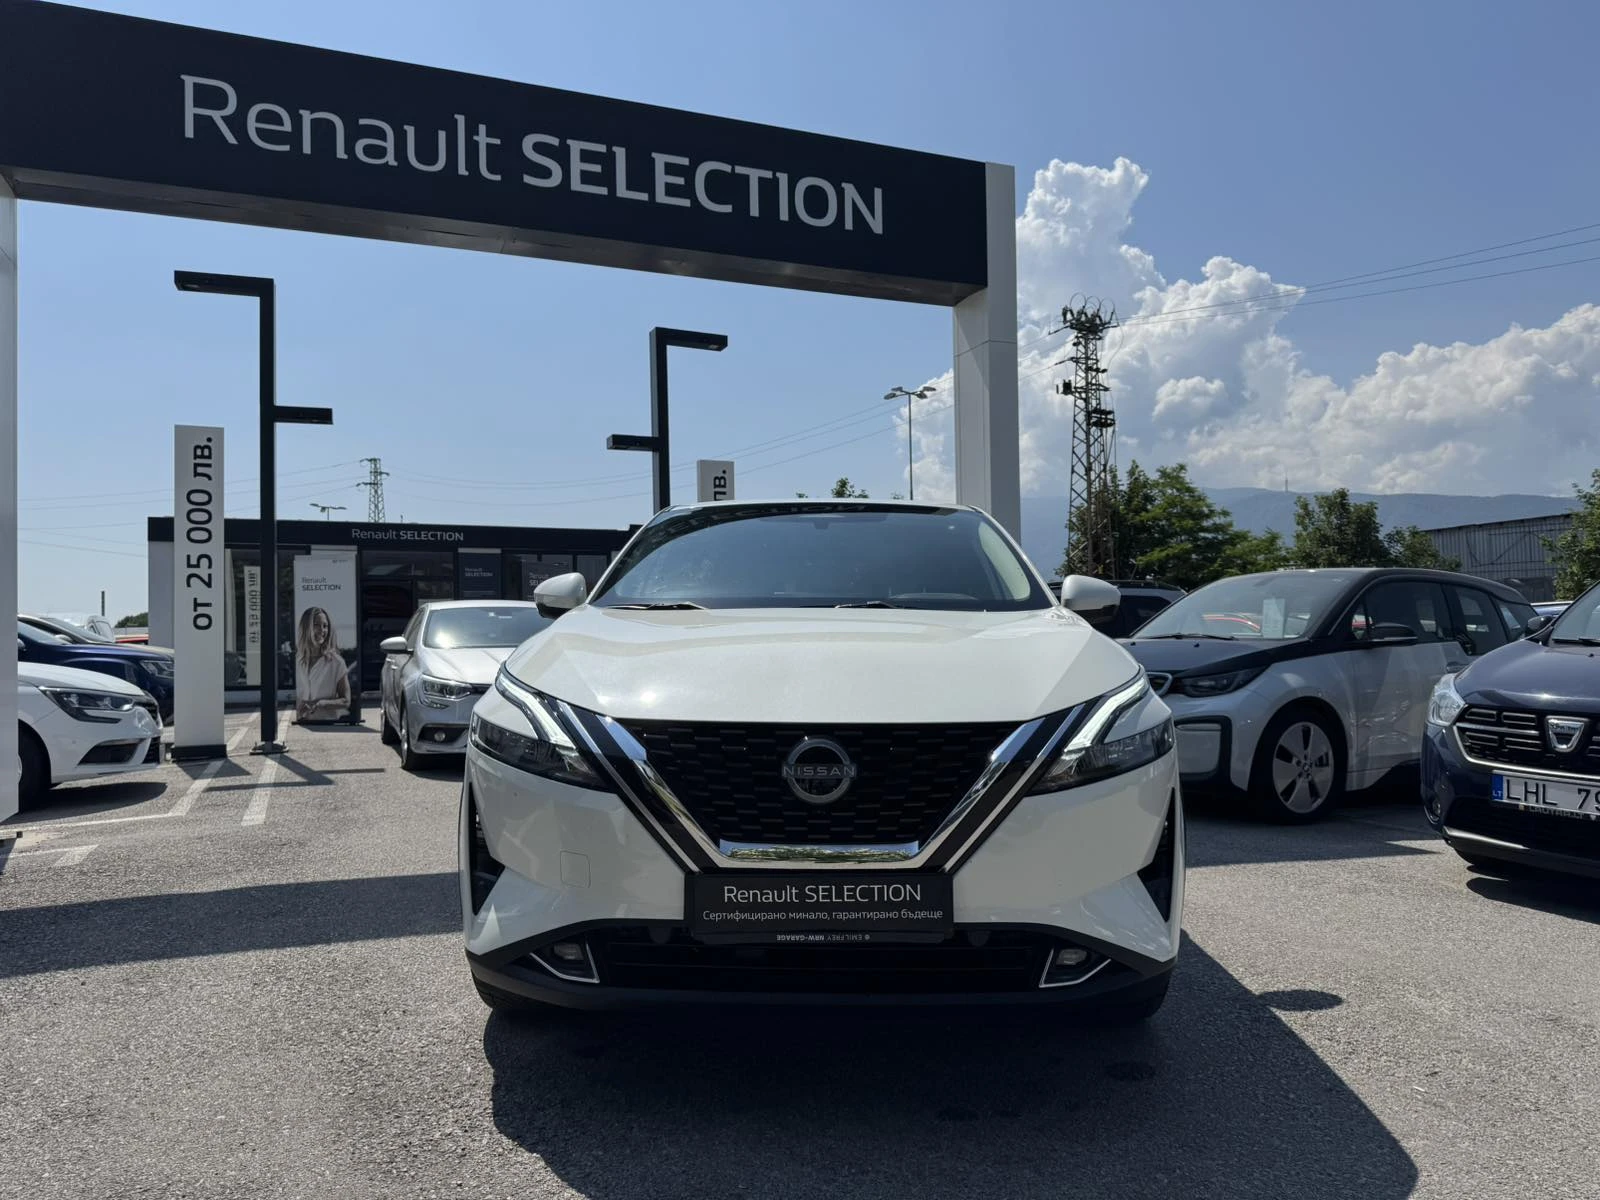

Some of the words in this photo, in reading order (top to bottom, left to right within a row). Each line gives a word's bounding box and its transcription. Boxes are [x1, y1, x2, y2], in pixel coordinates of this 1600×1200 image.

[180, 74, 501, 182] Renault
[522, 132, 884, 236] SELECTION
[186, 488, 213, 545] 000
[351, 528, 397, 540] Renault
[399, 530, 465, 542] SELECTION
[186, 553, 213, 589] 25
[301, 576, 327, 584] Renault
[301, 584, 342, 592] SELECTION
[783, 766, 855, 776] NISSAN
[1506, 779, 1558, 806] LHL
[723, 884, 800, 904] Renault
[804, 883, 922, 904] SELECTION
[702, 909, 787, 922] Сертифицирано
[789, 911, 831, 921] минало,
[832, 910, 899, 922] гарантирано
[901, 908, 943, 920] бъдеще
